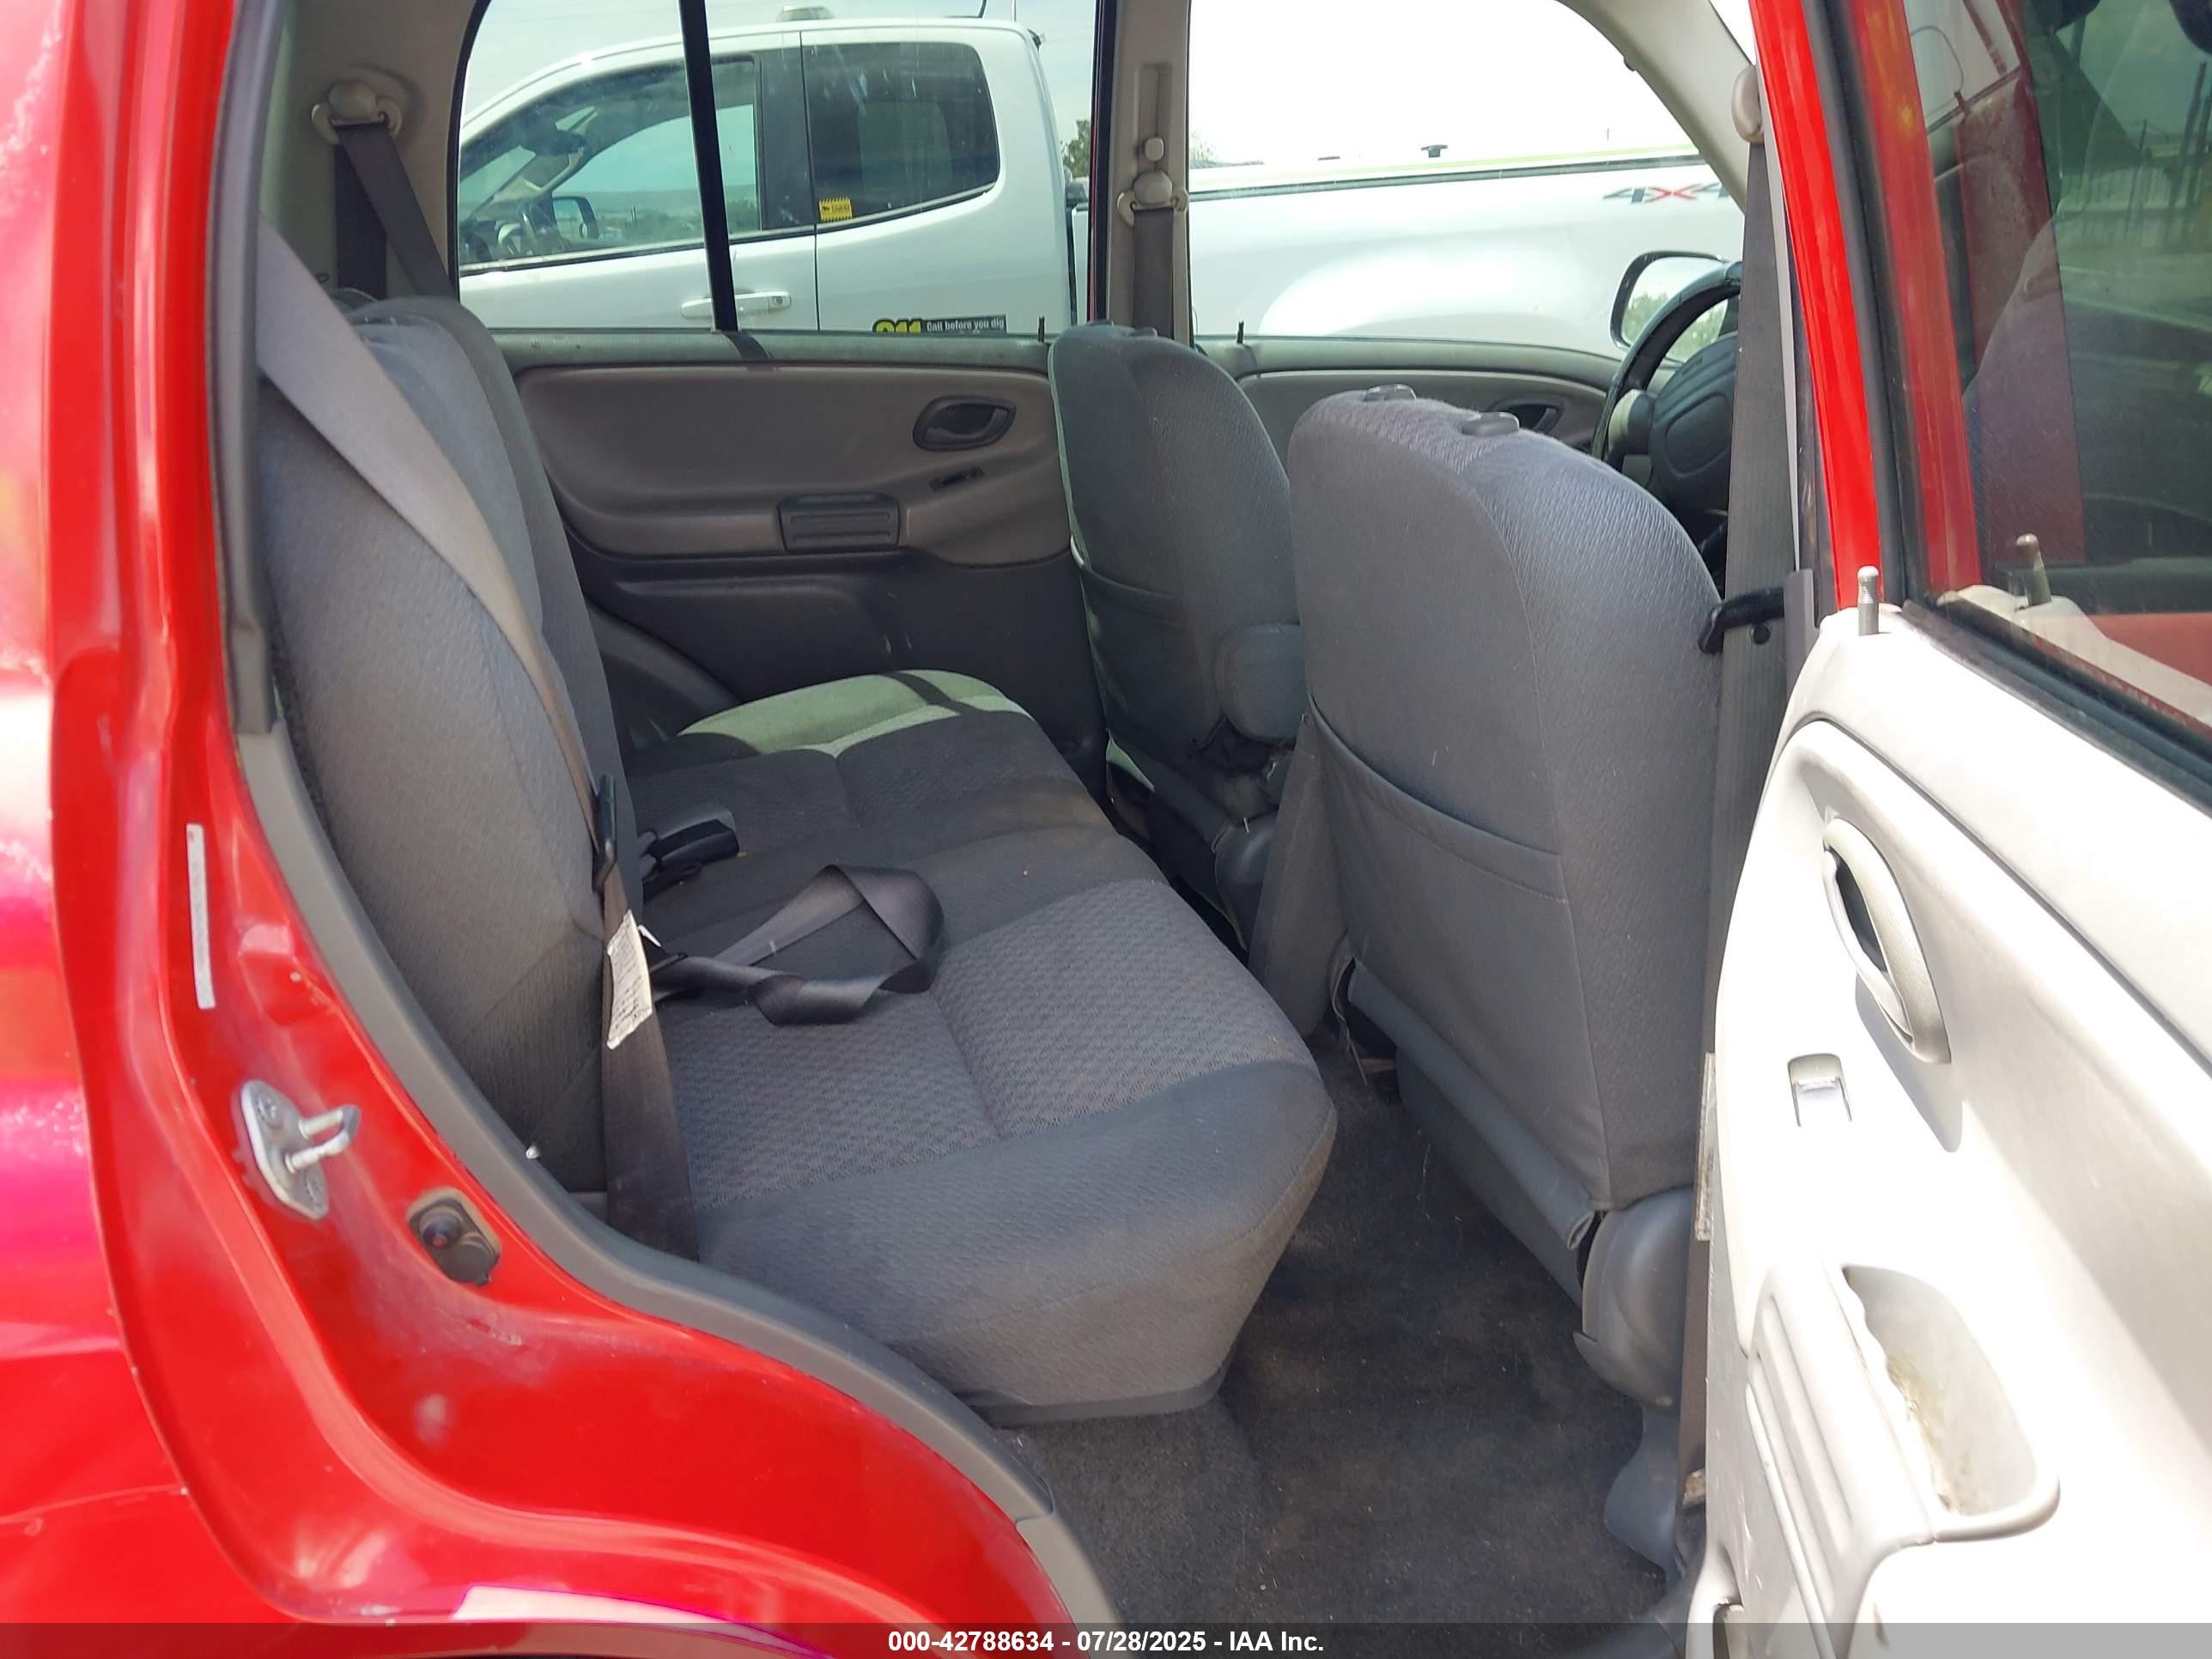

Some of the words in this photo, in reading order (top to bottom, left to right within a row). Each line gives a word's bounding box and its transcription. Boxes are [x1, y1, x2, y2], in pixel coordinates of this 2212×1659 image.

[927, 321, 943, 331] Call
[945, 319, 972, 331] before
[974, 319, 989, 331] you
[991, 318, 1004, 330] dig
